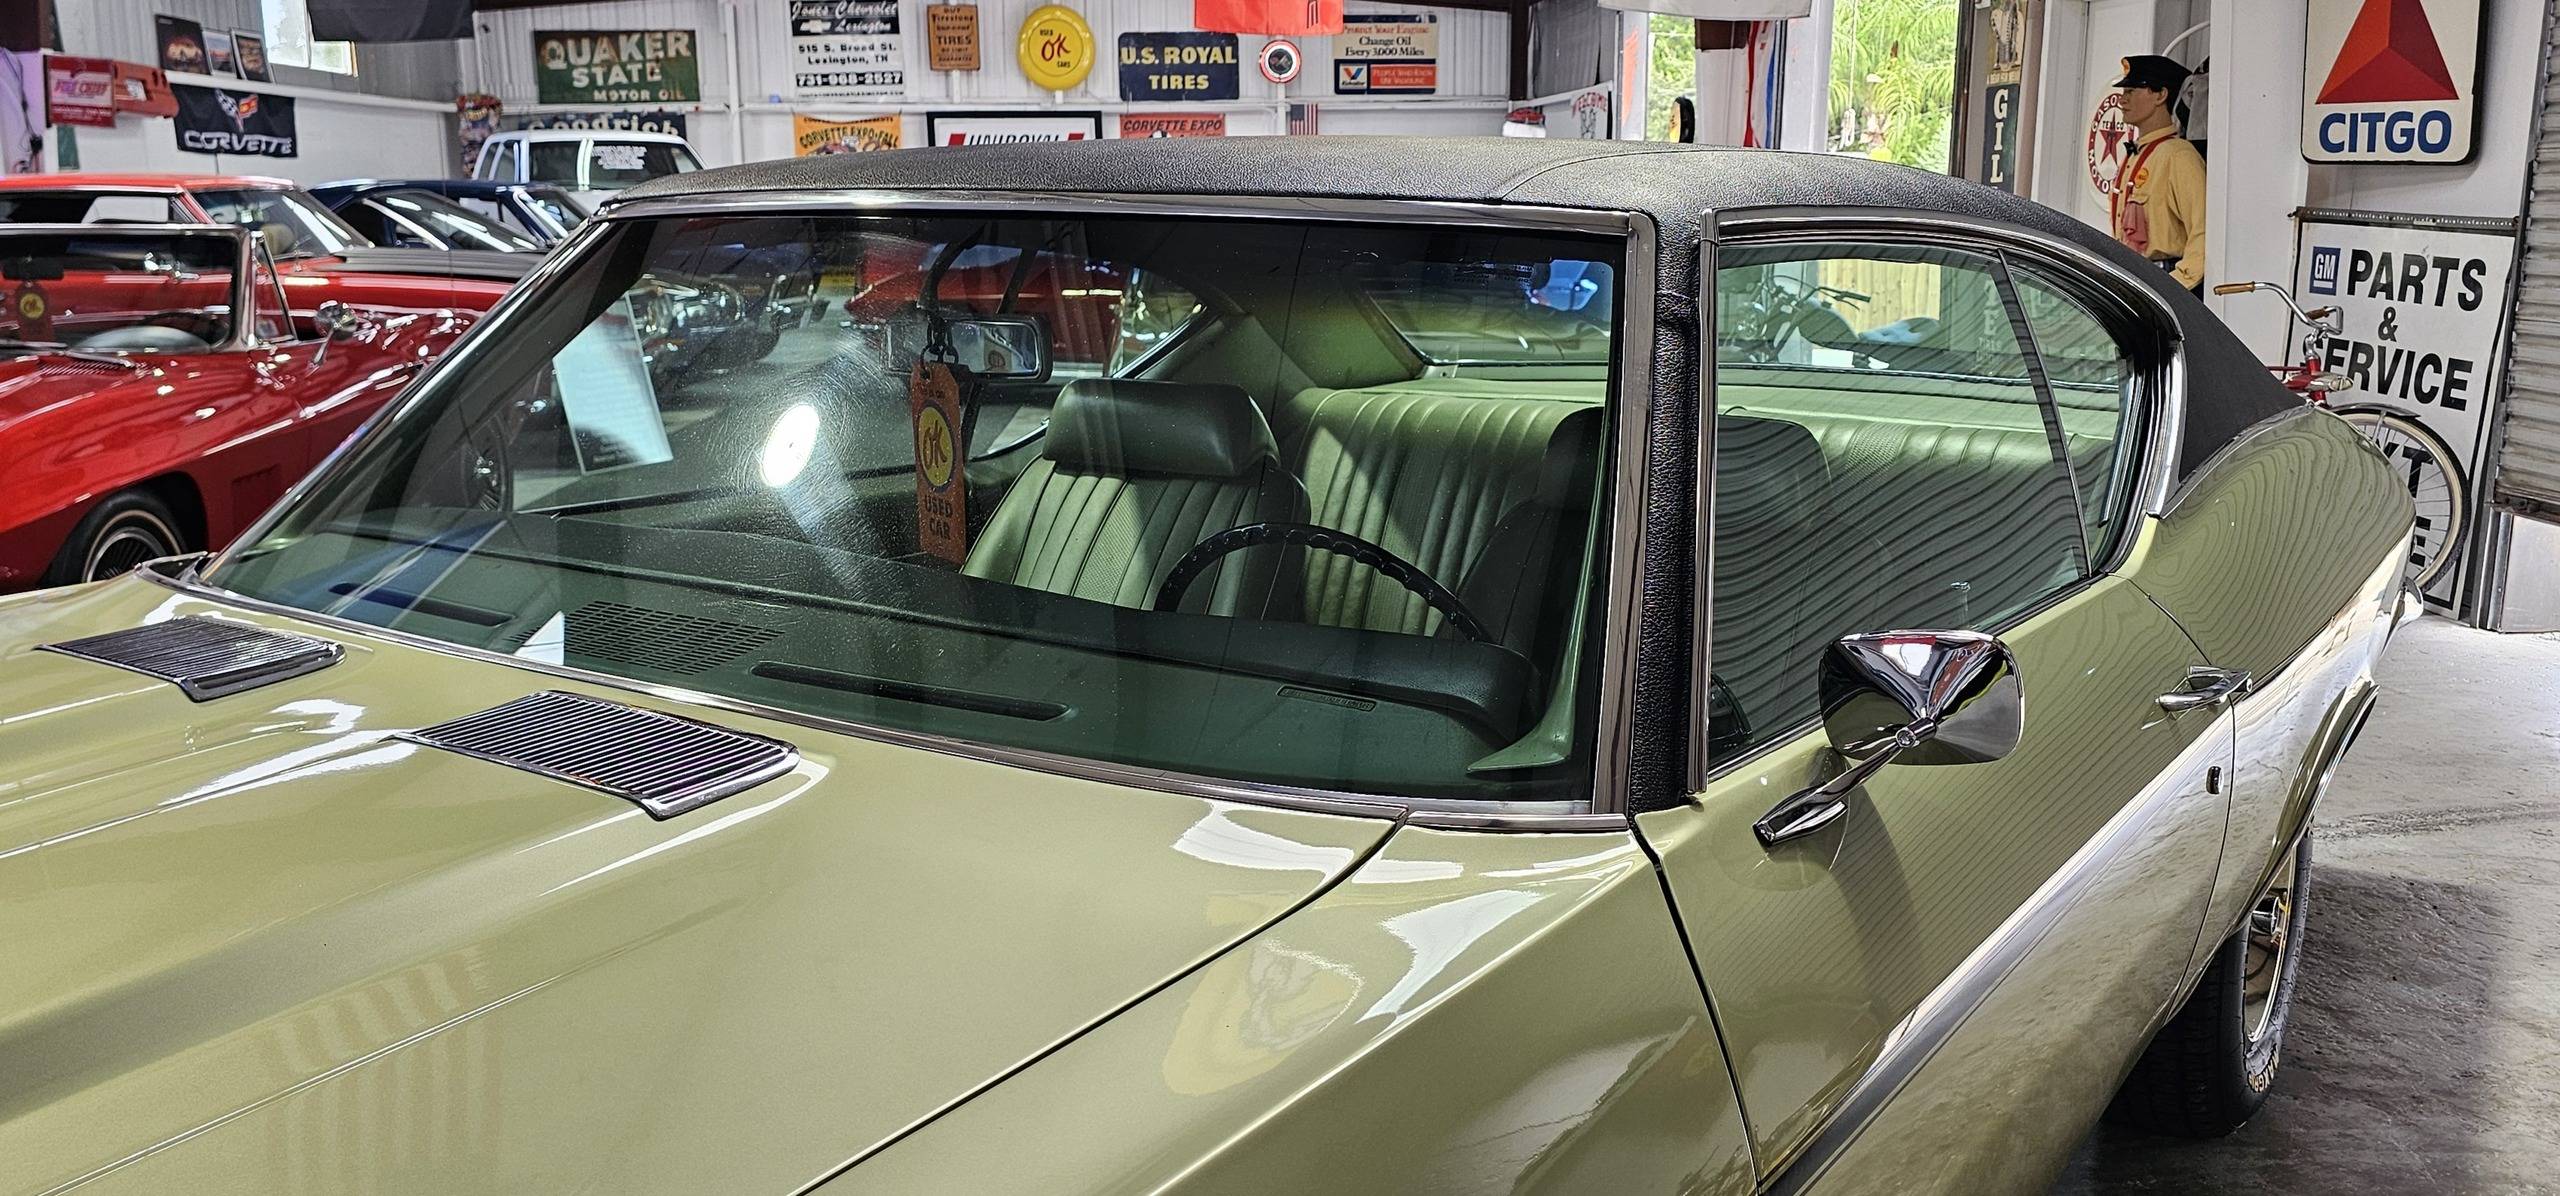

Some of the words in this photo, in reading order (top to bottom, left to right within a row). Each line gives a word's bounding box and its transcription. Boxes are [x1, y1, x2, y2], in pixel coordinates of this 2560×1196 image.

[792, 0, 829, 20] Jones
[835, 0, 897, 19] Chevrolet
[540, 32, 691, 69] QUAKER
[937, 36, 972, 45] TIRES
[1041, 32, 1072, 63] OK
[1345, 47, 1371, 57] Every
[1399, 47, 1425, 57] Miles
[1359, 36, 1394, 46] Change
[1396, 36, 1412, 45] Oil
[1120, 46, 1160, 65] U.S.
[1164, 46, 1238, 65] ROYAL
[572, 62, 662, 88] STATE
[1148, 74, 1210, 91] TIRES
[593, 88, 651, 102] MOTOR
[658, 87, 686, 101] OIL
[800, 126, 848, 149] CORVETTE
[1123, 120, 1186, 132] CORVETTE
[1190, 120, 1222, 131] EXPO
[2319, 110, 2452, 154] CITGO
[184, 130, 292, 154] CORVETTE
[1990, 88, 2009, 189] GIL
[2314, 253, 2336, 281] GM
[2347, 248, 2487, 312] PARTS
[2378, 306, 2398, 342] &
[923, 419, 948, 470] OK
